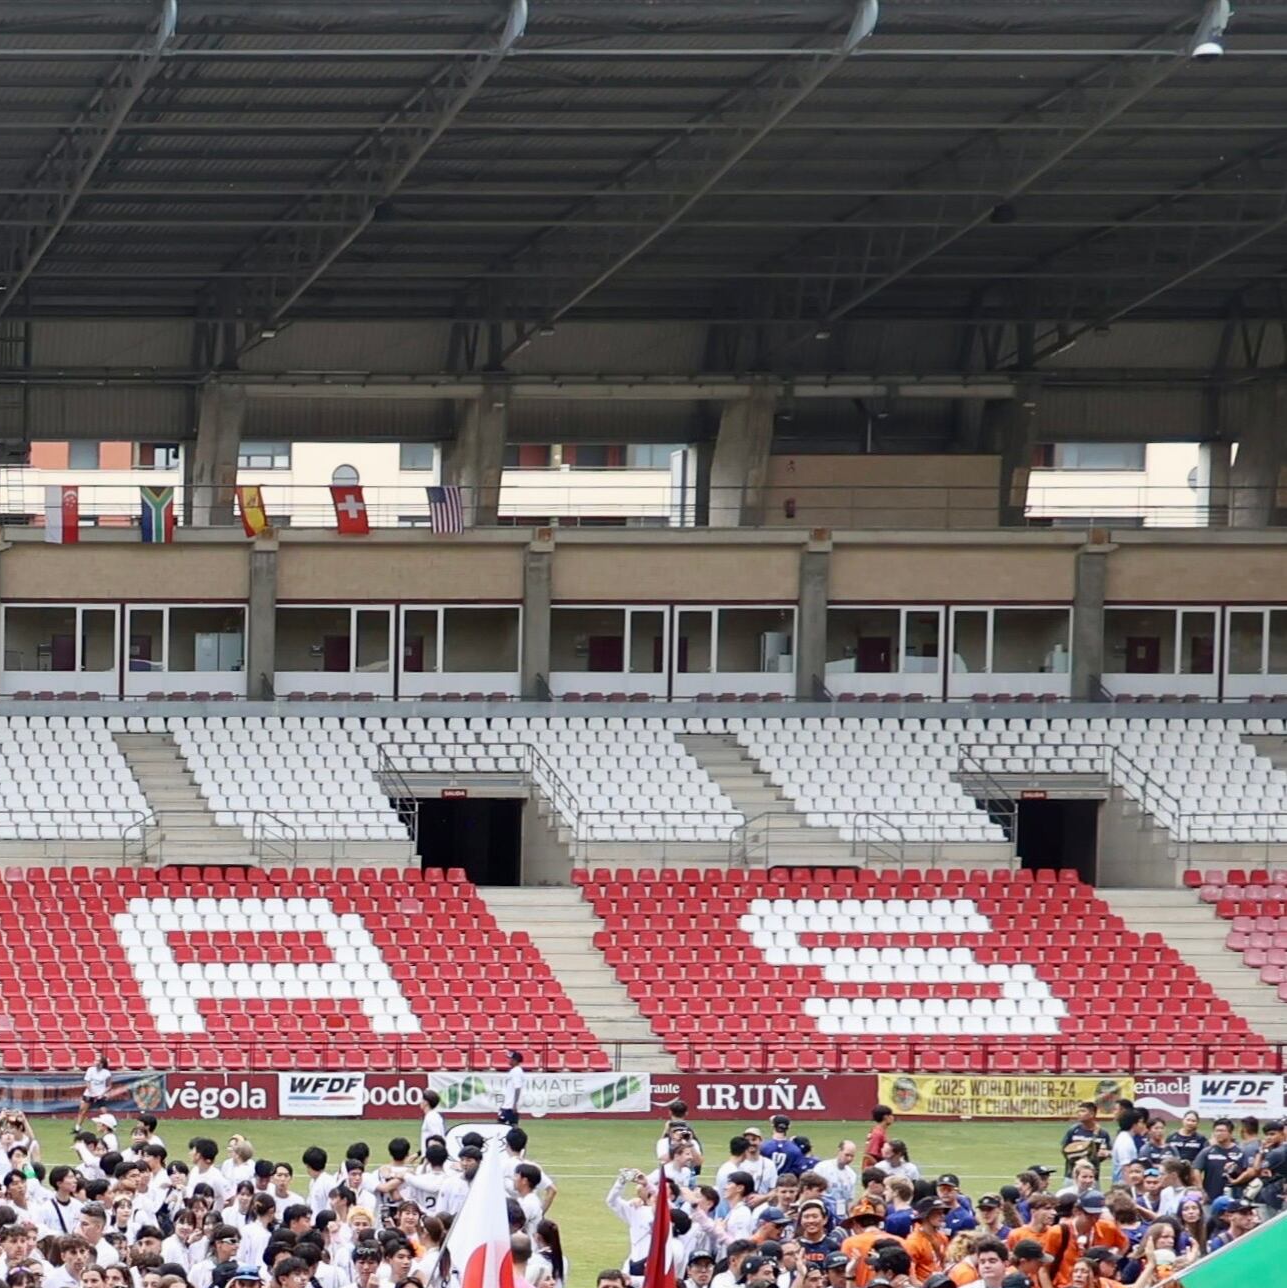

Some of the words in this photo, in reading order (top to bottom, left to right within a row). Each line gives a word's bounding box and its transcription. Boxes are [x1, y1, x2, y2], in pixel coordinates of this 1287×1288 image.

[290, 1077, 363, 1093] WFDF
[935, 1079, 967, 1096] 2025
[970, 1079, 1012, 1096] WORLD
[1015, 1080, 1076, 1098] UNDER-24
[1201, 1080, 1275, 1096] WFDF
[696, 1077, 826, 1110] IRUÑA
[928, 1099, 981, 1114] ULTIMATE
